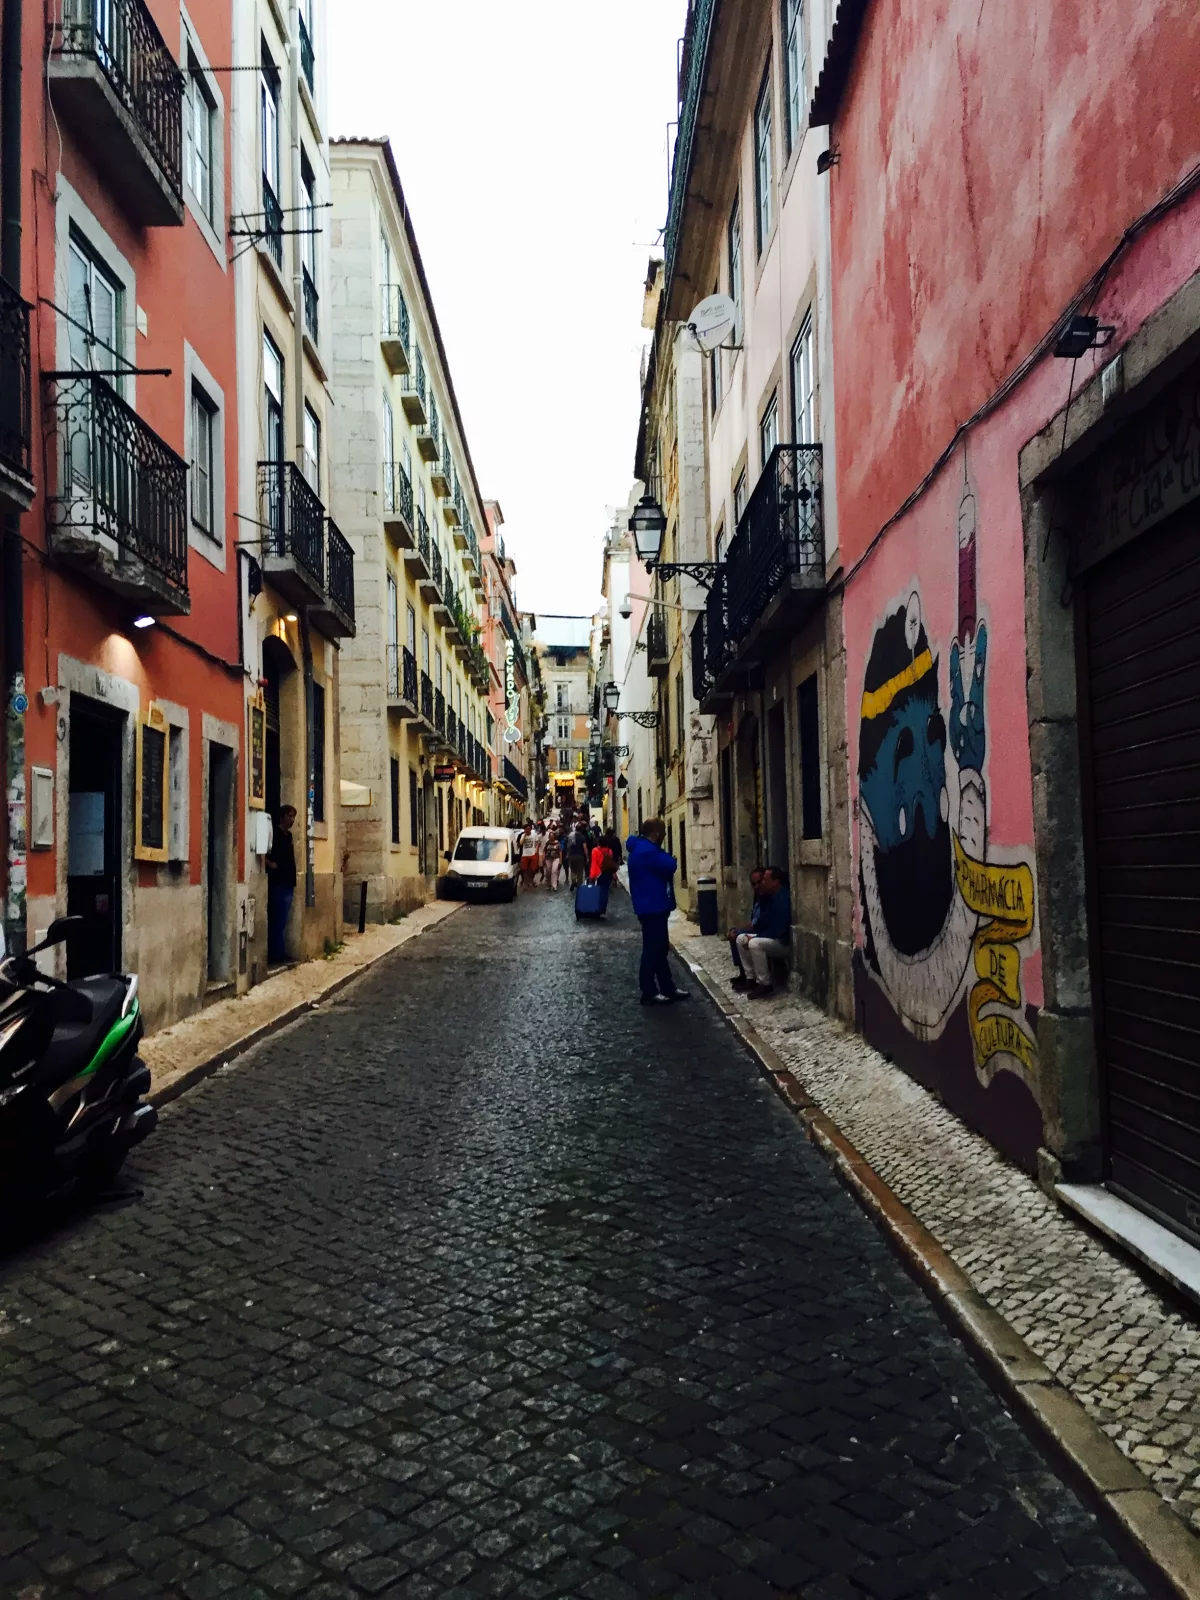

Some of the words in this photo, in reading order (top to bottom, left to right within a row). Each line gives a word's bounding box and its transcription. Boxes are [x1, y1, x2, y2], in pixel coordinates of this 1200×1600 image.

[505, 639, 515, 698] MACHADO
[989, 948, 1007, 986] DE
[978, 1017, 1022, 1059] CULTURA
